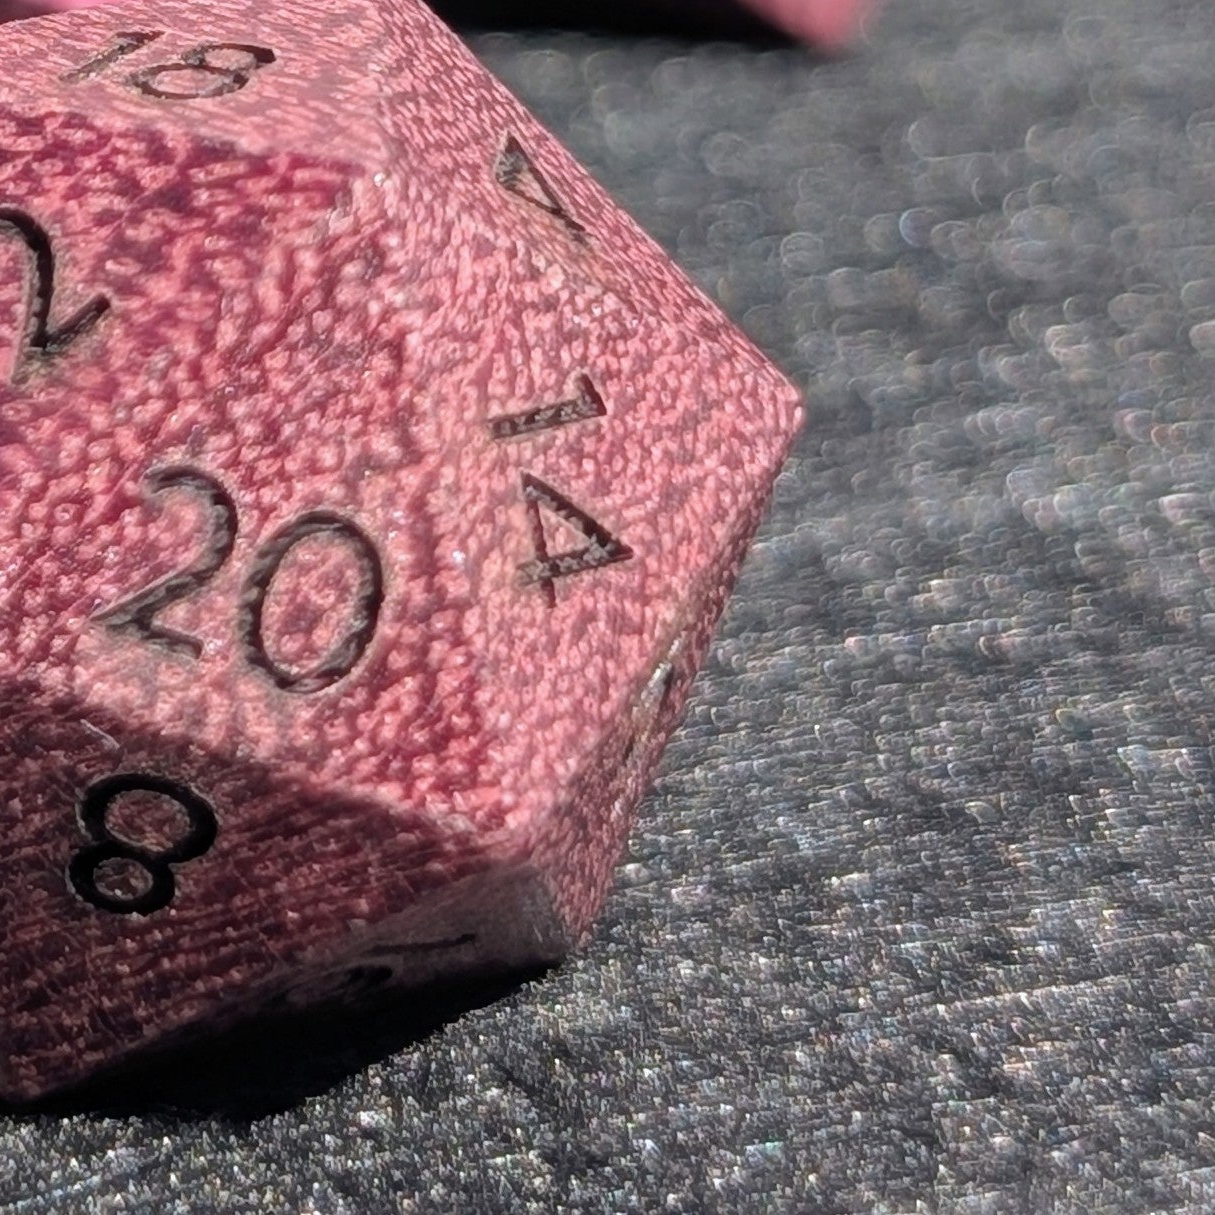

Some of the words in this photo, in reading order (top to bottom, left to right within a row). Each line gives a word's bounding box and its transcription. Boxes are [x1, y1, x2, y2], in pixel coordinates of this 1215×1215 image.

[494, 130, 590, 244] 4
[90, 464, 384, 696] 20
[488, 372, 634, 608] 14
[66, 772, 220, 918] 8
